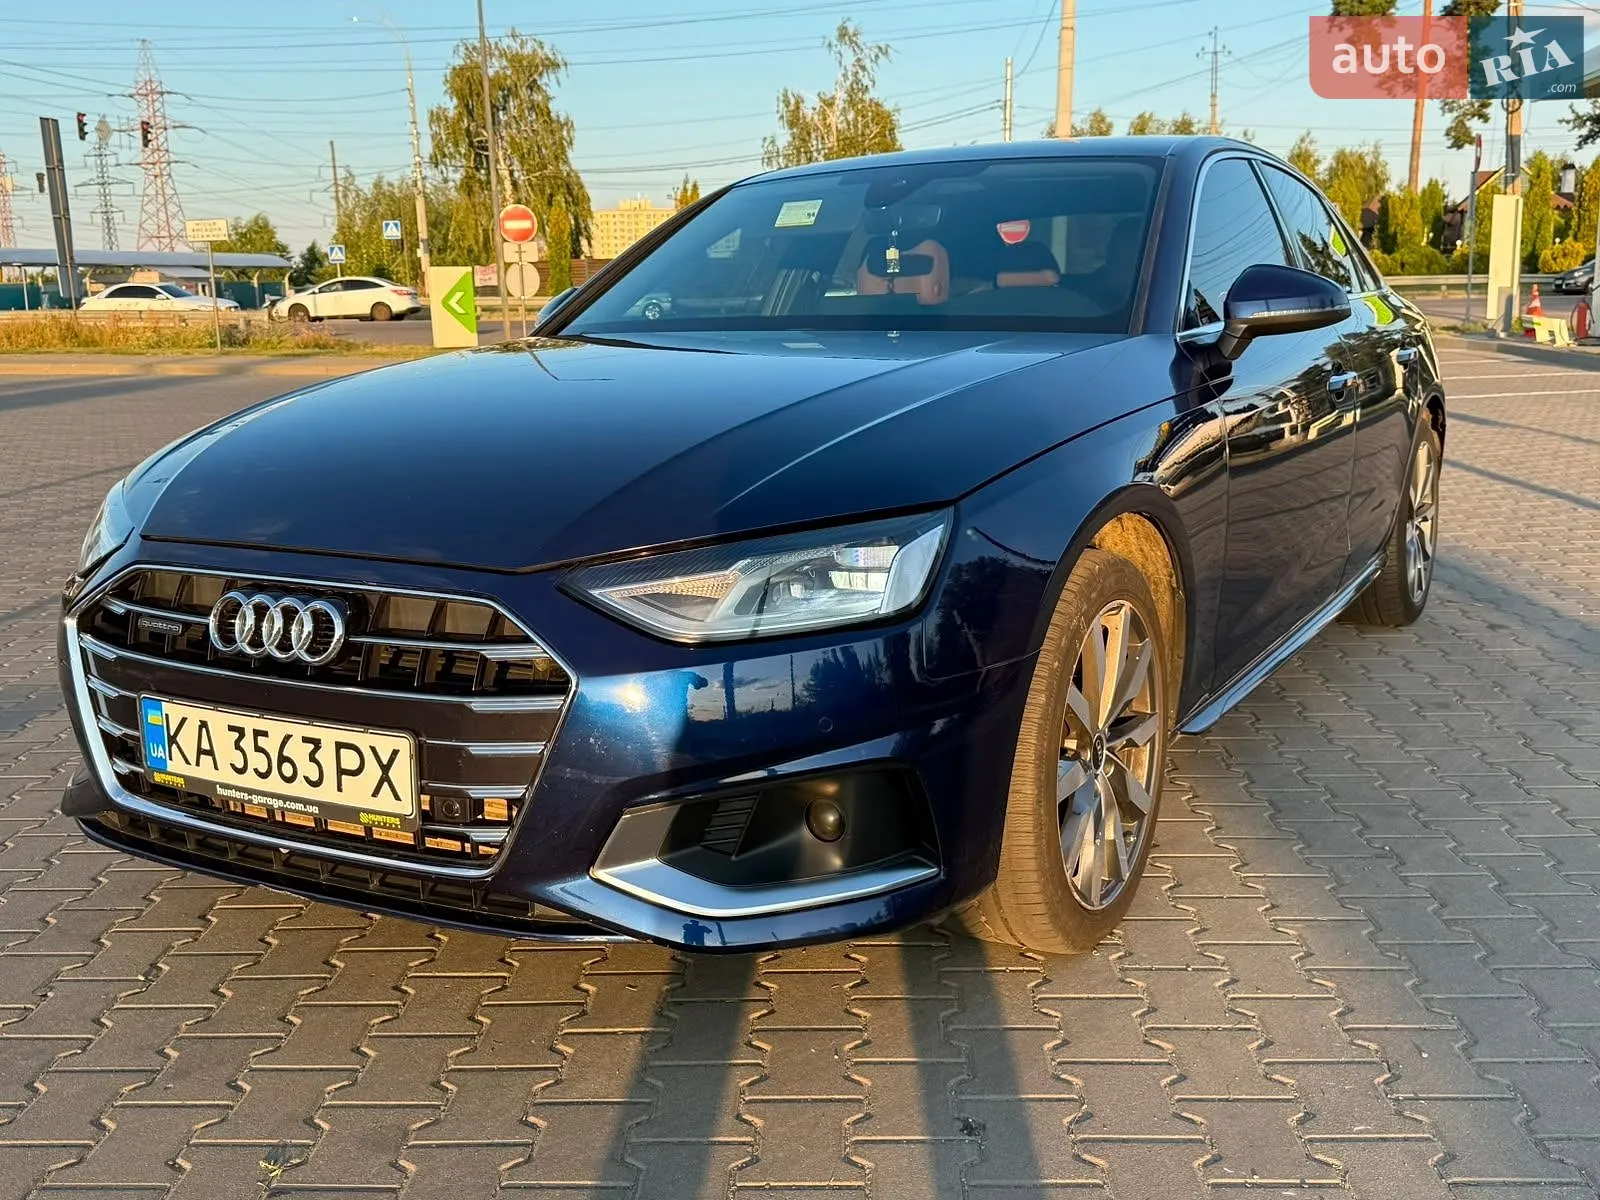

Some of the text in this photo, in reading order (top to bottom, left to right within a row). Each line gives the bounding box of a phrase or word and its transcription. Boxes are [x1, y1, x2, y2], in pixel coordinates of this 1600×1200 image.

[141, 619, 180, 632] quattro
[150, 743, 166, 760] UA
[165, 713, 402, 802] KA 3563 PX
[216, 783, 320, 814] hunters-garage.com.ua
